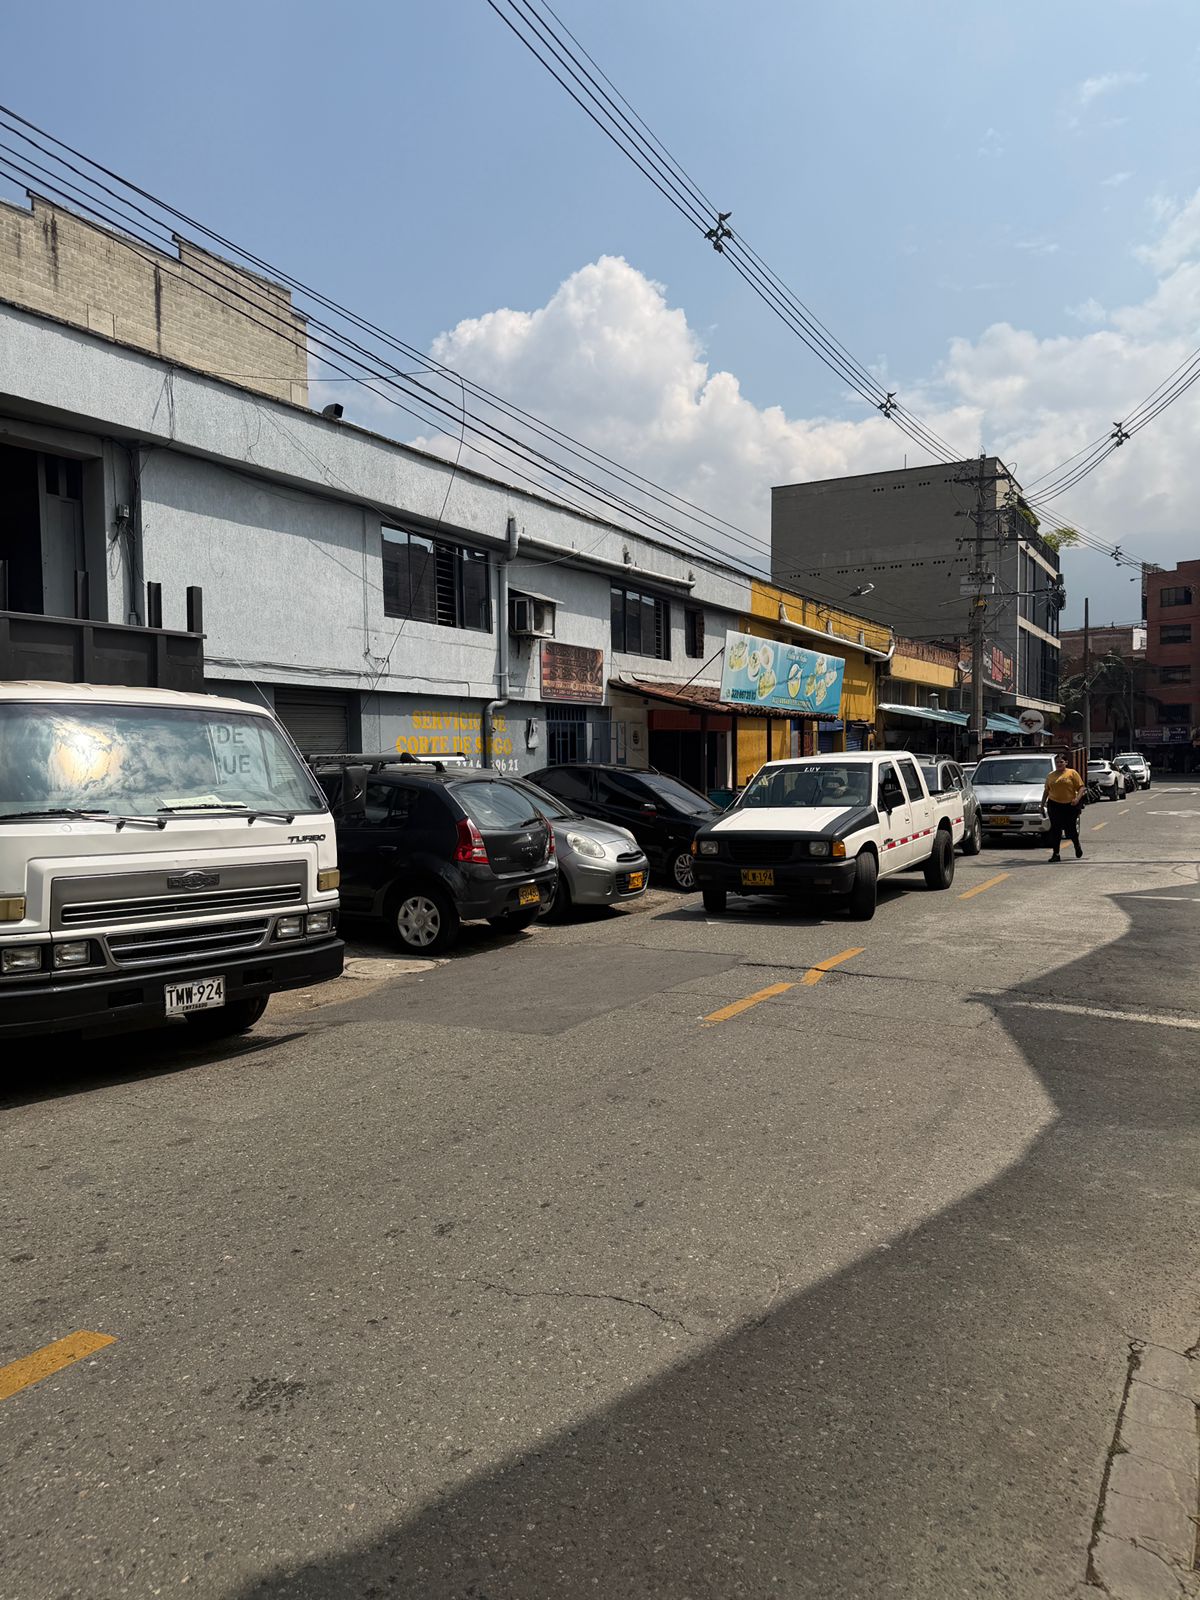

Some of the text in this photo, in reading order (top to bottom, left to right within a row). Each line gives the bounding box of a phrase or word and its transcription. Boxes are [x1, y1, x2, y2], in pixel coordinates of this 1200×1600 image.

[395, 735, 449, 755] CORTE
[452, 735, 473, 755] DE
[287, 834, 326, 843] TURBO
